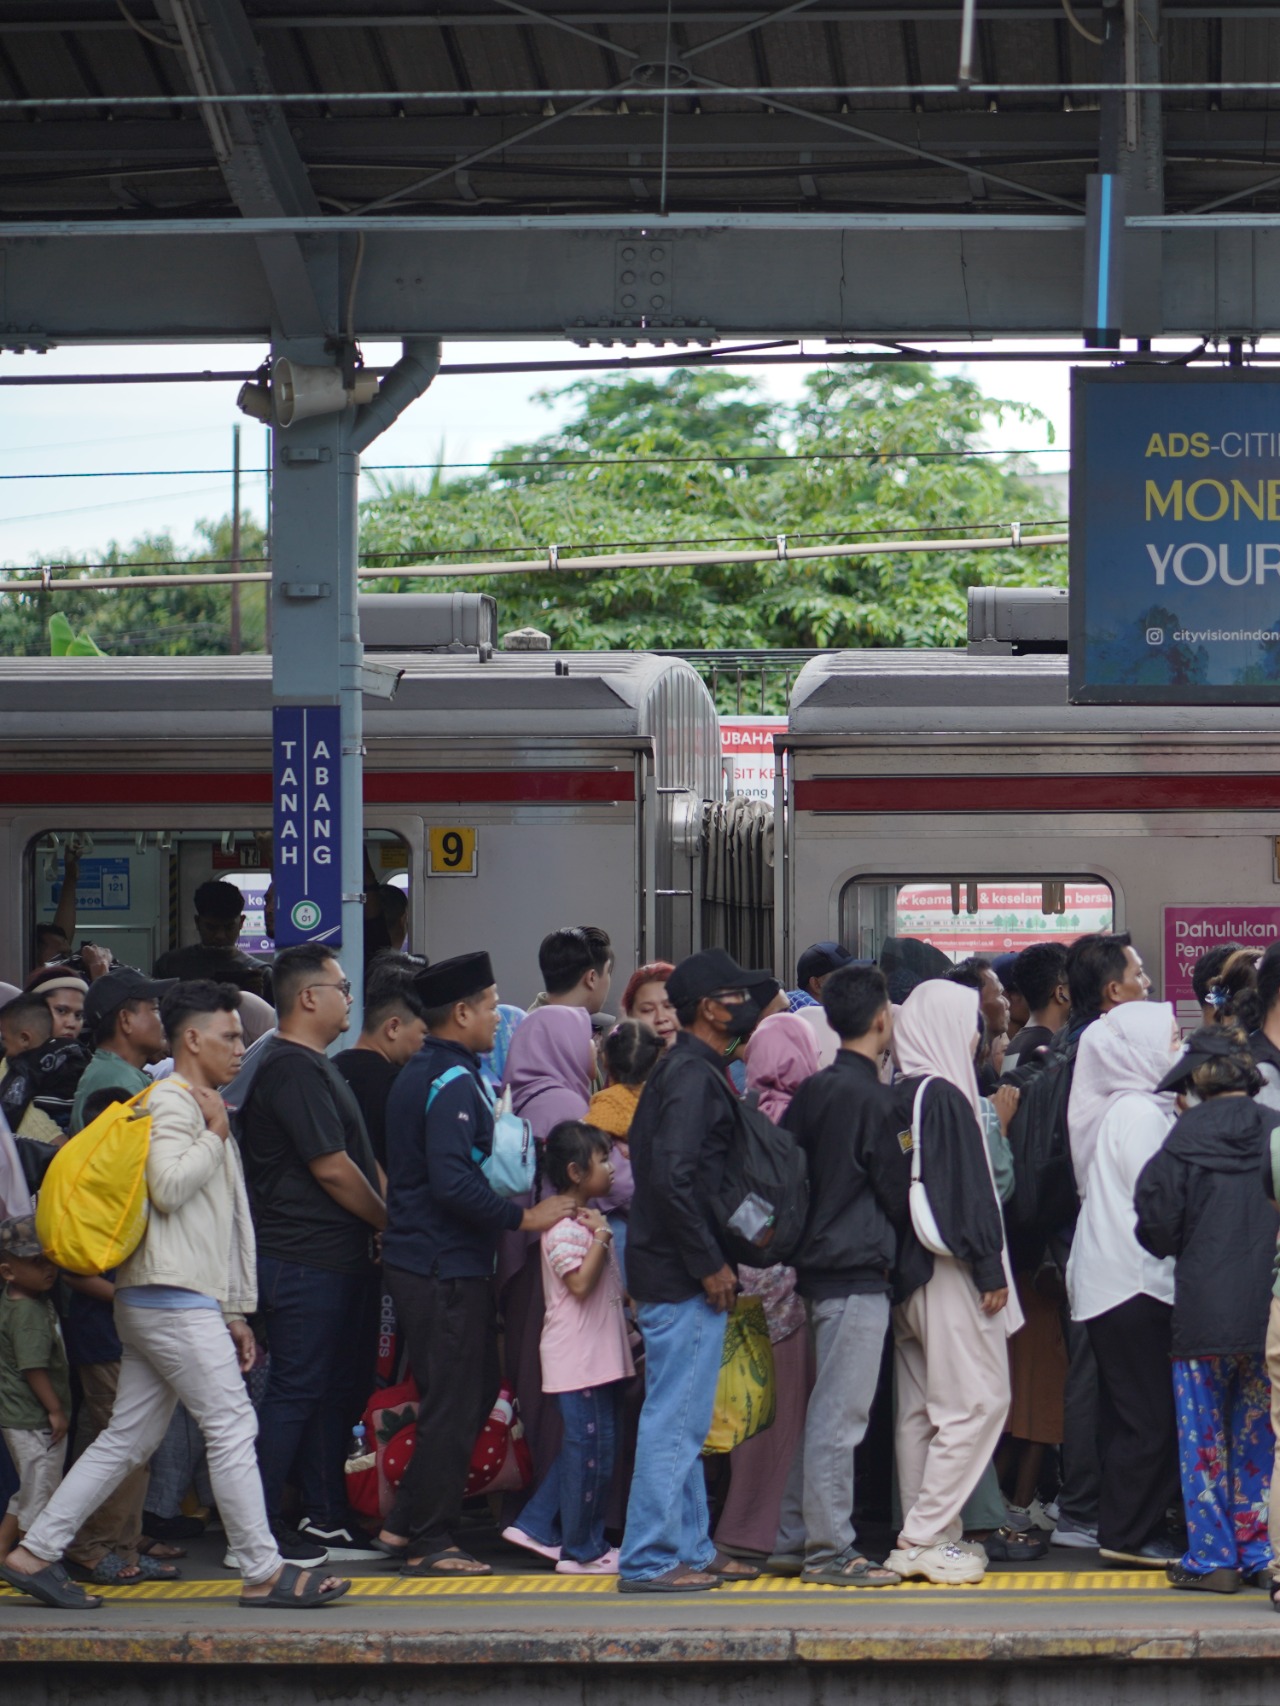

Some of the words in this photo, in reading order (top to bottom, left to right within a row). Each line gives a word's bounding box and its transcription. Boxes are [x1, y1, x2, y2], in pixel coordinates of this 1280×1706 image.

[721, 731, 774, 745] UBAHA
[280, 741, 298, 865] TANAH
[312, 740, 332, 865] ABANG
[442, 831, 464, 867] 9
[108, 883, 124, 892] 121
[980, 892, 989, 904] &
[1175, 921, 1278, 938] Dahulukan
[379, 1294, 396, 1358] adidas
